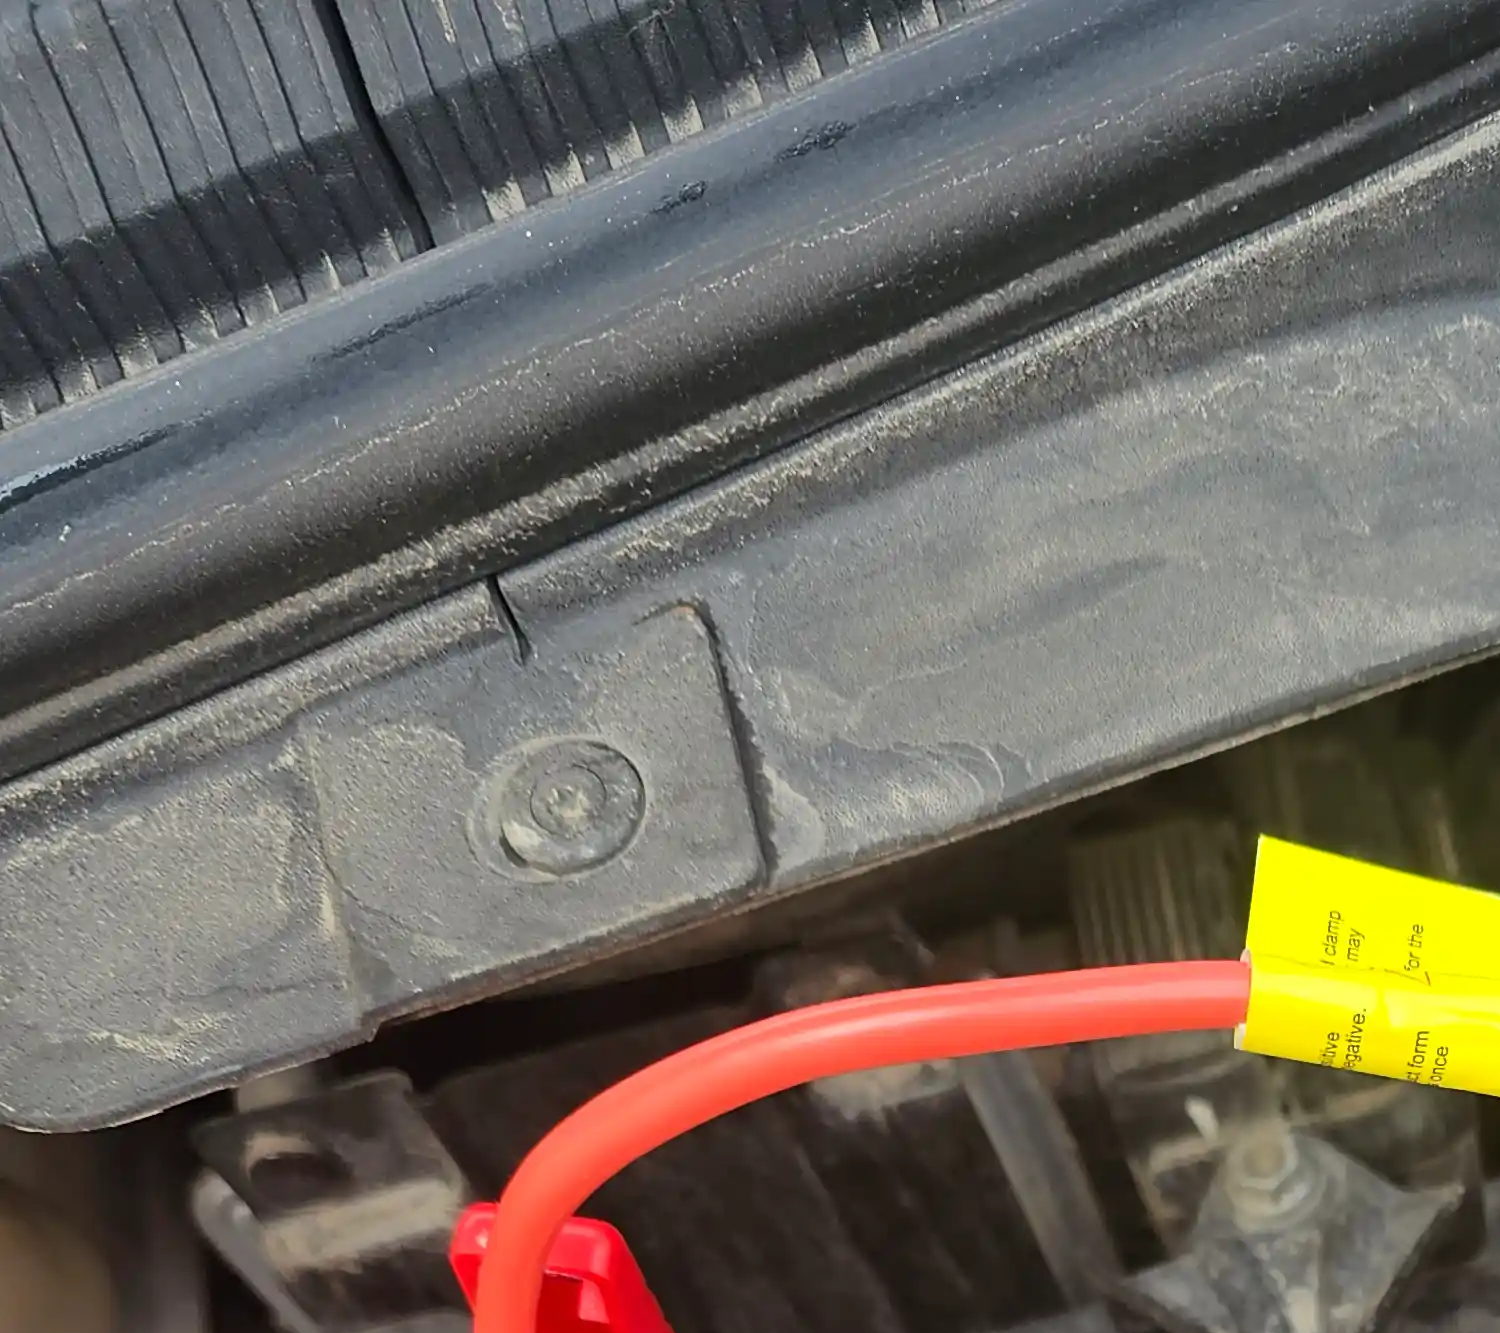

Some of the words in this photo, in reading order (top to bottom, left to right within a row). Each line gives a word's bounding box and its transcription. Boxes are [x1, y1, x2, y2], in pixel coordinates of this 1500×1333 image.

[1322, 910, 1343, 957] clamp
[1346, 927, 1365, 962] may
[1408, 923, 1424, 948] the
[1320, 1031, 1340, 1067] sitive
[1343, 1007, 1367, 1068] egative.
[1407, 1030, 1430, 1069] form
